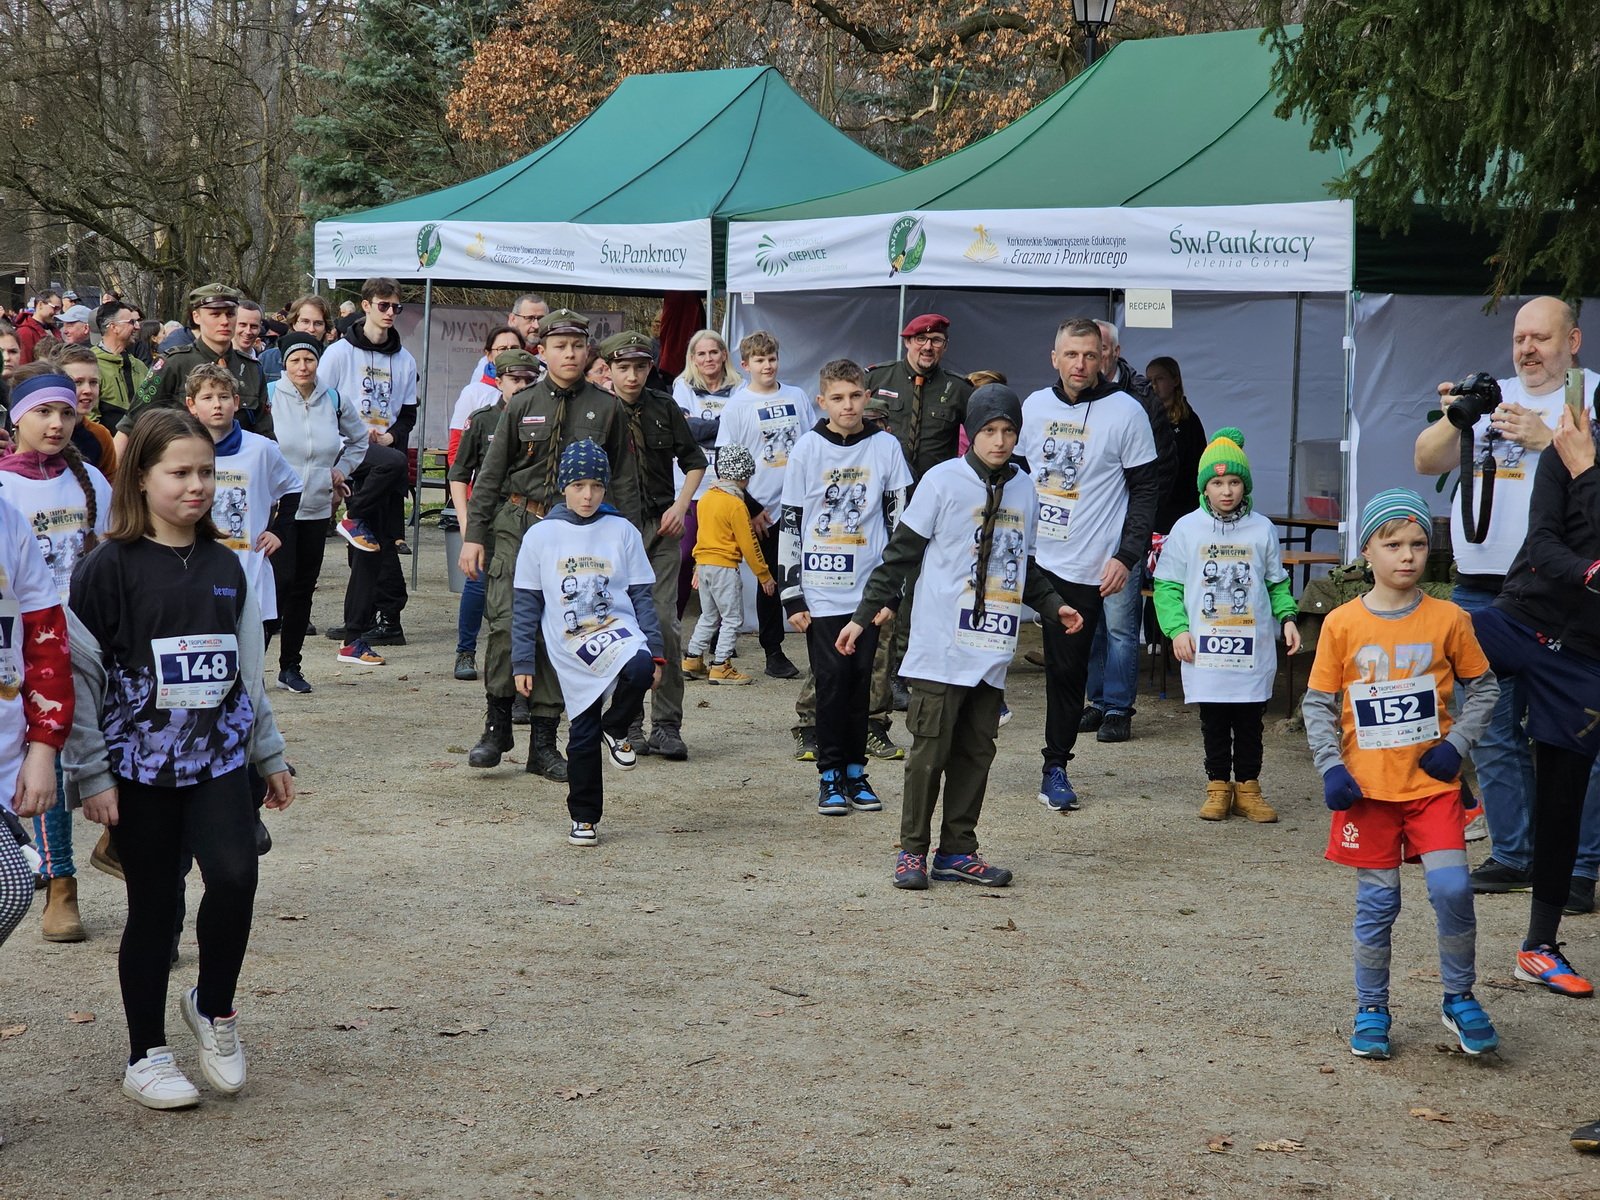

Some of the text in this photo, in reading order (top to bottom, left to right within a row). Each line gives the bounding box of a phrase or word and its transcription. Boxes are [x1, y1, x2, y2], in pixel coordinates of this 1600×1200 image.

[353, 245, 377, 255] CIEPLICE
[1006, 235, 1127, 248] Karkonoskie Stowarzyszenie Edukacyjne
[788, 248, 828, 261] CIEPLICE
[1011, 249, 1052, 264] Erazma
[1053, 249, 1060, 264] i
[1061, 249, 1128, 268] Pankracego
[1187, 256, 1289, 269] Jelenia Góra
[1129, 302, 1166, 310] RECEPCJA
[766, 405, 788, 419] 151
[1040, 504, 1062, 523] 62
[808, 554, 847, 571] 088
[585, 630, 621, 657] 091
[1207, 637, 1245, 655] 092
[176, 653, 228, 681] 148
[1369, 695, 1421, 724] 152
